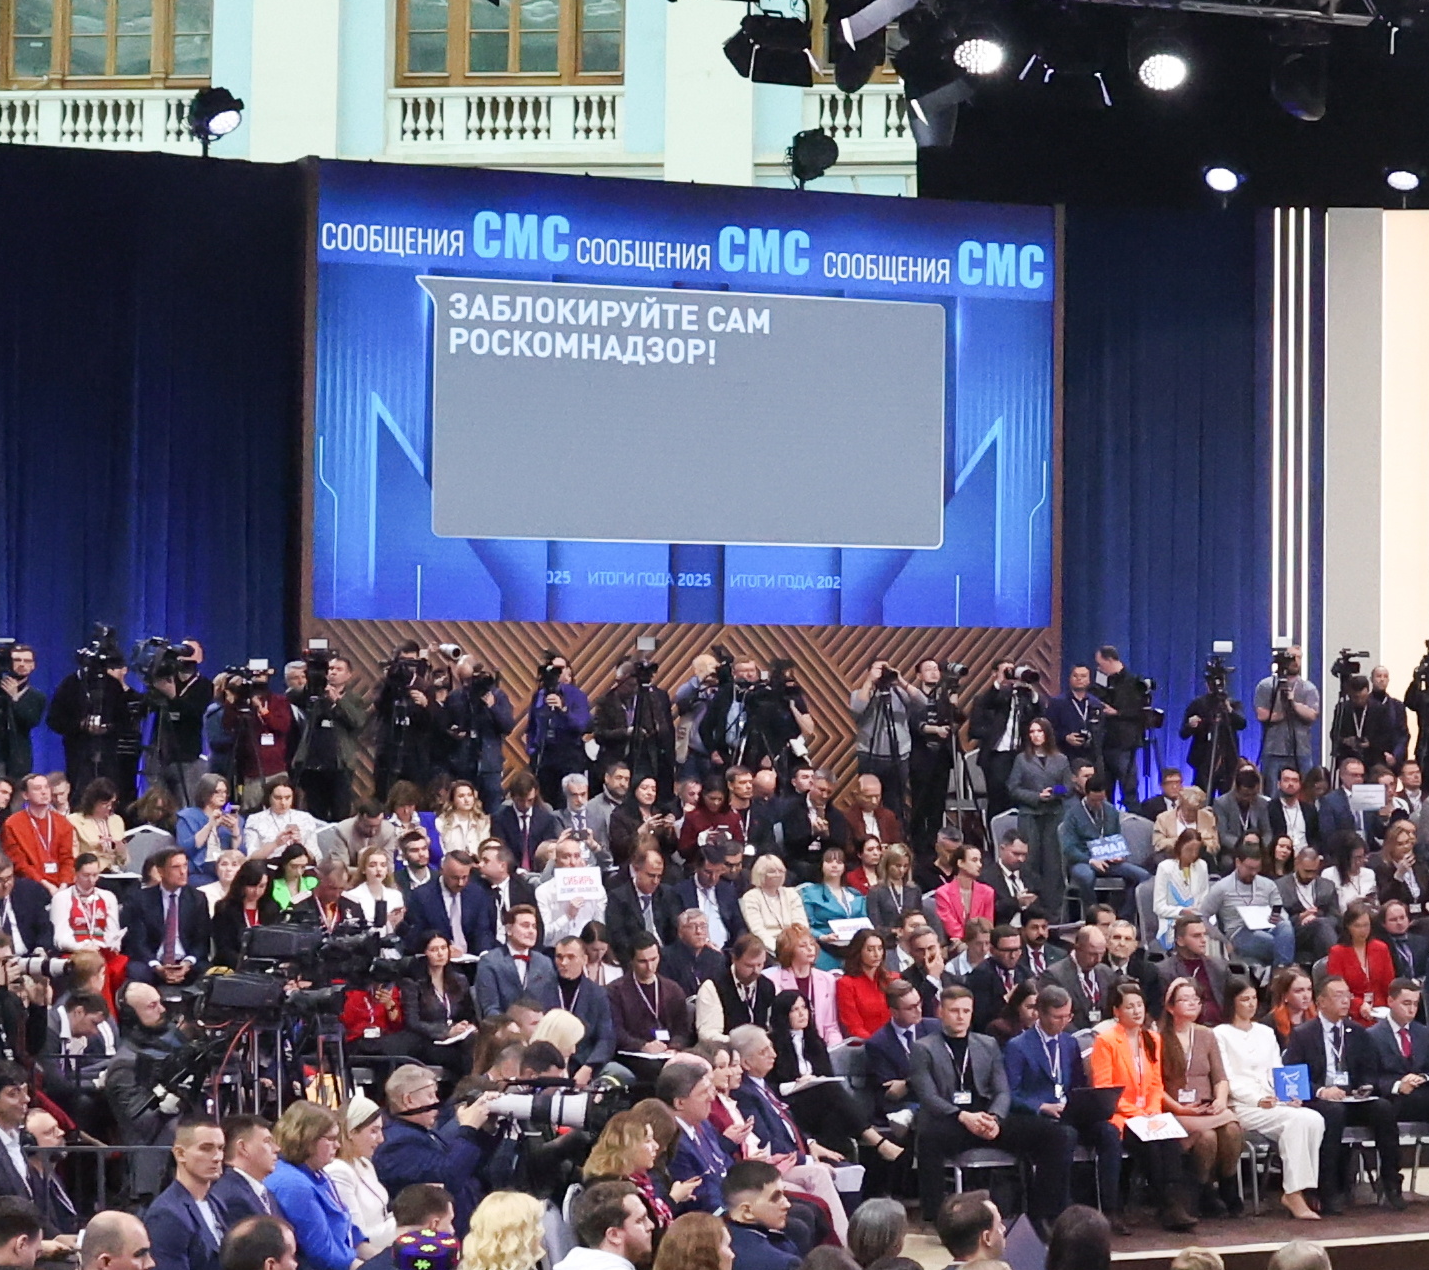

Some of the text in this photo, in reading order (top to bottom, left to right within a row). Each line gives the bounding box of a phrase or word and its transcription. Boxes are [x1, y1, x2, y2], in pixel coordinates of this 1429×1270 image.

[321, 211, 1044, 289] СООБЩЕНИЯ СМС СООБЩЕНИЯ СМС СООБЩЕНИЯ СМС
[449, 292, 770, 334] ЗАБЛОКИРУЙТЕ САМ
[449, 327, 716, 365] РОСКОМНАДЗОР!
[588, 571, 711, 587] ИТОГИ ГОДА 2025
[730, 574, 841, 590] ИТОГИ ГОДА 202
[1092, 841, 1126, 856] ЯМАЛ
[563, 875, 594, 886] СИБИРЬ
